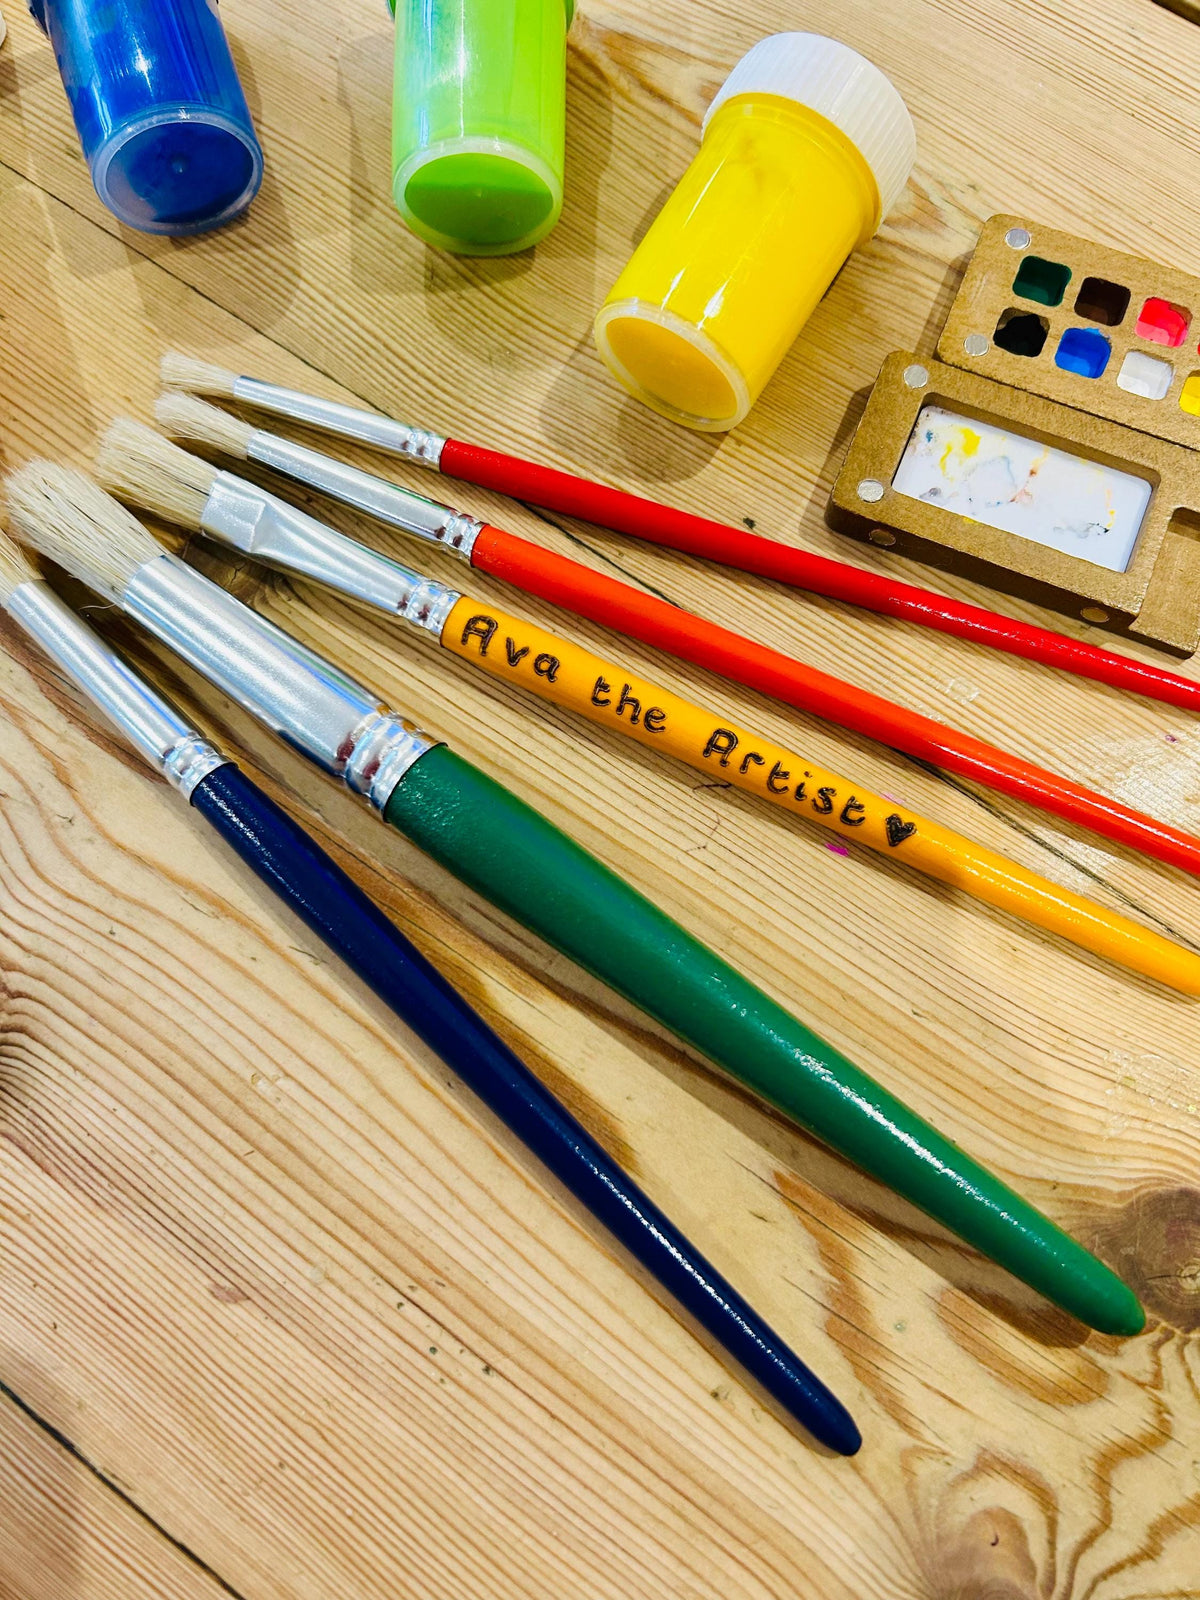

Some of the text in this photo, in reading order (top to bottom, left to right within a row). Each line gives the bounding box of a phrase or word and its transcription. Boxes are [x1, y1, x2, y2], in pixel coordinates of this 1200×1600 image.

[461, 614, 867, 827] Ava the Artist
